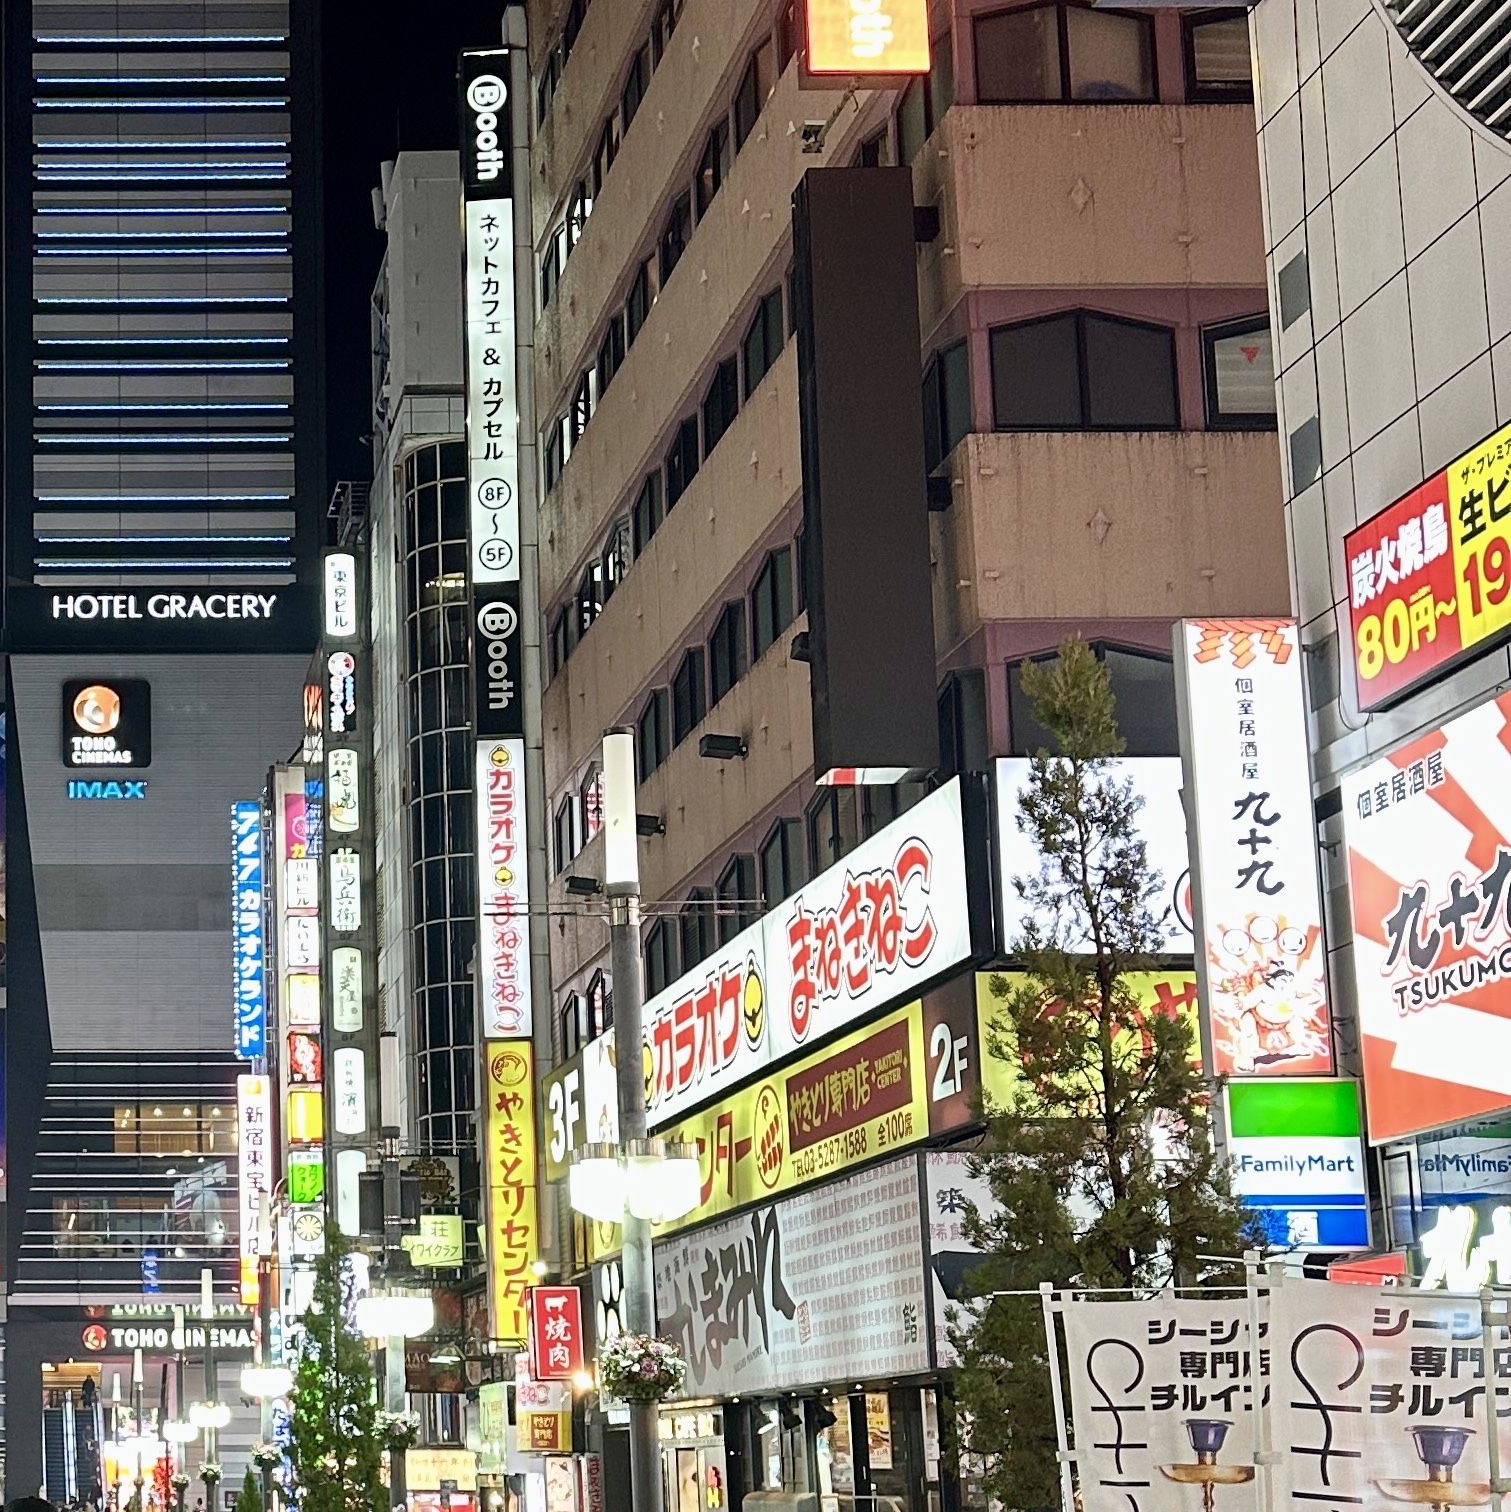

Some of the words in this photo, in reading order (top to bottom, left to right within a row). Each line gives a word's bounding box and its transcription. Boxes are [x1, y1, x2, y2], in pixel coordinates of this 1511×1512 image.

[466, 74, 508, 182] Booth
[478, 213, 502, 336] ネットカフェ
[482, 347, 501, 367] &
[482, 376, 504, 461] カプセル
[1350, 501, 1448, 610] 炭火焼鳥
[52, 594, 143, 619] HOTEL
[147, 593, 278, 619] GRACERY
[333, 570, 349, 628] 東京ビル
[476, 601, 517, 710] Booth
[71, 736, 116, 750] TOHO
[71, 750, 132, 764] CINEMAS
[1233, 677, 1260, 780] 個室居酒屋
[68, 780, 145, 799] IMAX
[489, 768, 516, 864] カラオケ
[1356, 750, 1444, 820] 個室居酒屋
[1231, 790, 1286, 896] 九十九
[491, 892, 522, 1033] まねきねこ
[787, 840, 936, 1041] まねきねこ
[651, 968, 745, 1098] カラオケ
[874, 1049, 903, 1075] YAKITORI
[931, 1022, 969, 1103] 2F
[549, 1070, 580, 1165] 3F
[789, 1057, 871, 1137] やきとり専門店
[876, 1068, 902, 1090] CENTER
[1240, 1154, 1355, 1177] FamilyMart
[495, 1091, 531, 1336] やきとりセンター
[110, 1328, 169, 1347] TOHO
[544, 1315, 573, 1369] 焼肉
